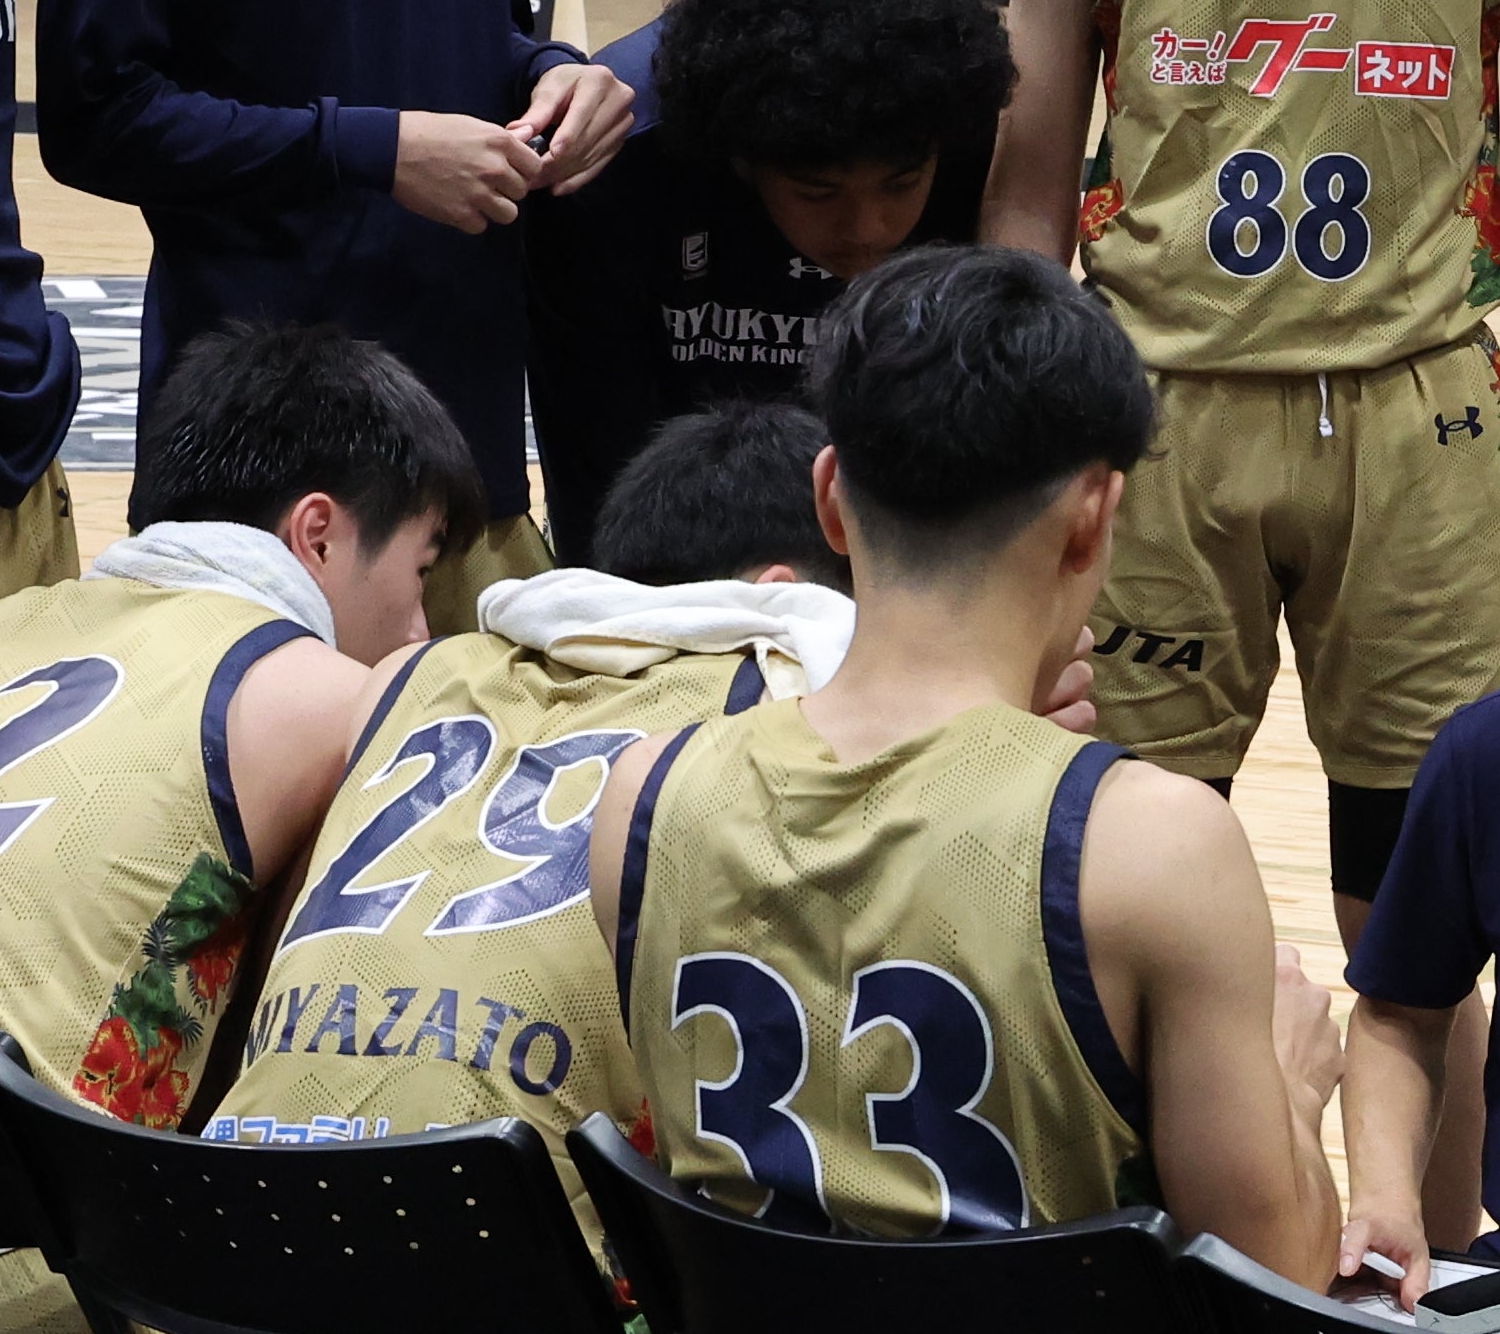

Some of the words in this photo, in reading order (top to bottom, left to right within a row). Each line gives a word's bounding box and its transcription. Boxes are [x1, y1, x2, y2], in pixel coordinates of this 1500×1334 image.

[1151, 60, 1226, 86] と言えば
[1205, 148, 1372, 283] 88
[1092, 625, 1204, 672] JTA
[277, 714, 649, 958] 29
[671, 950, 1032, 1236] 33
